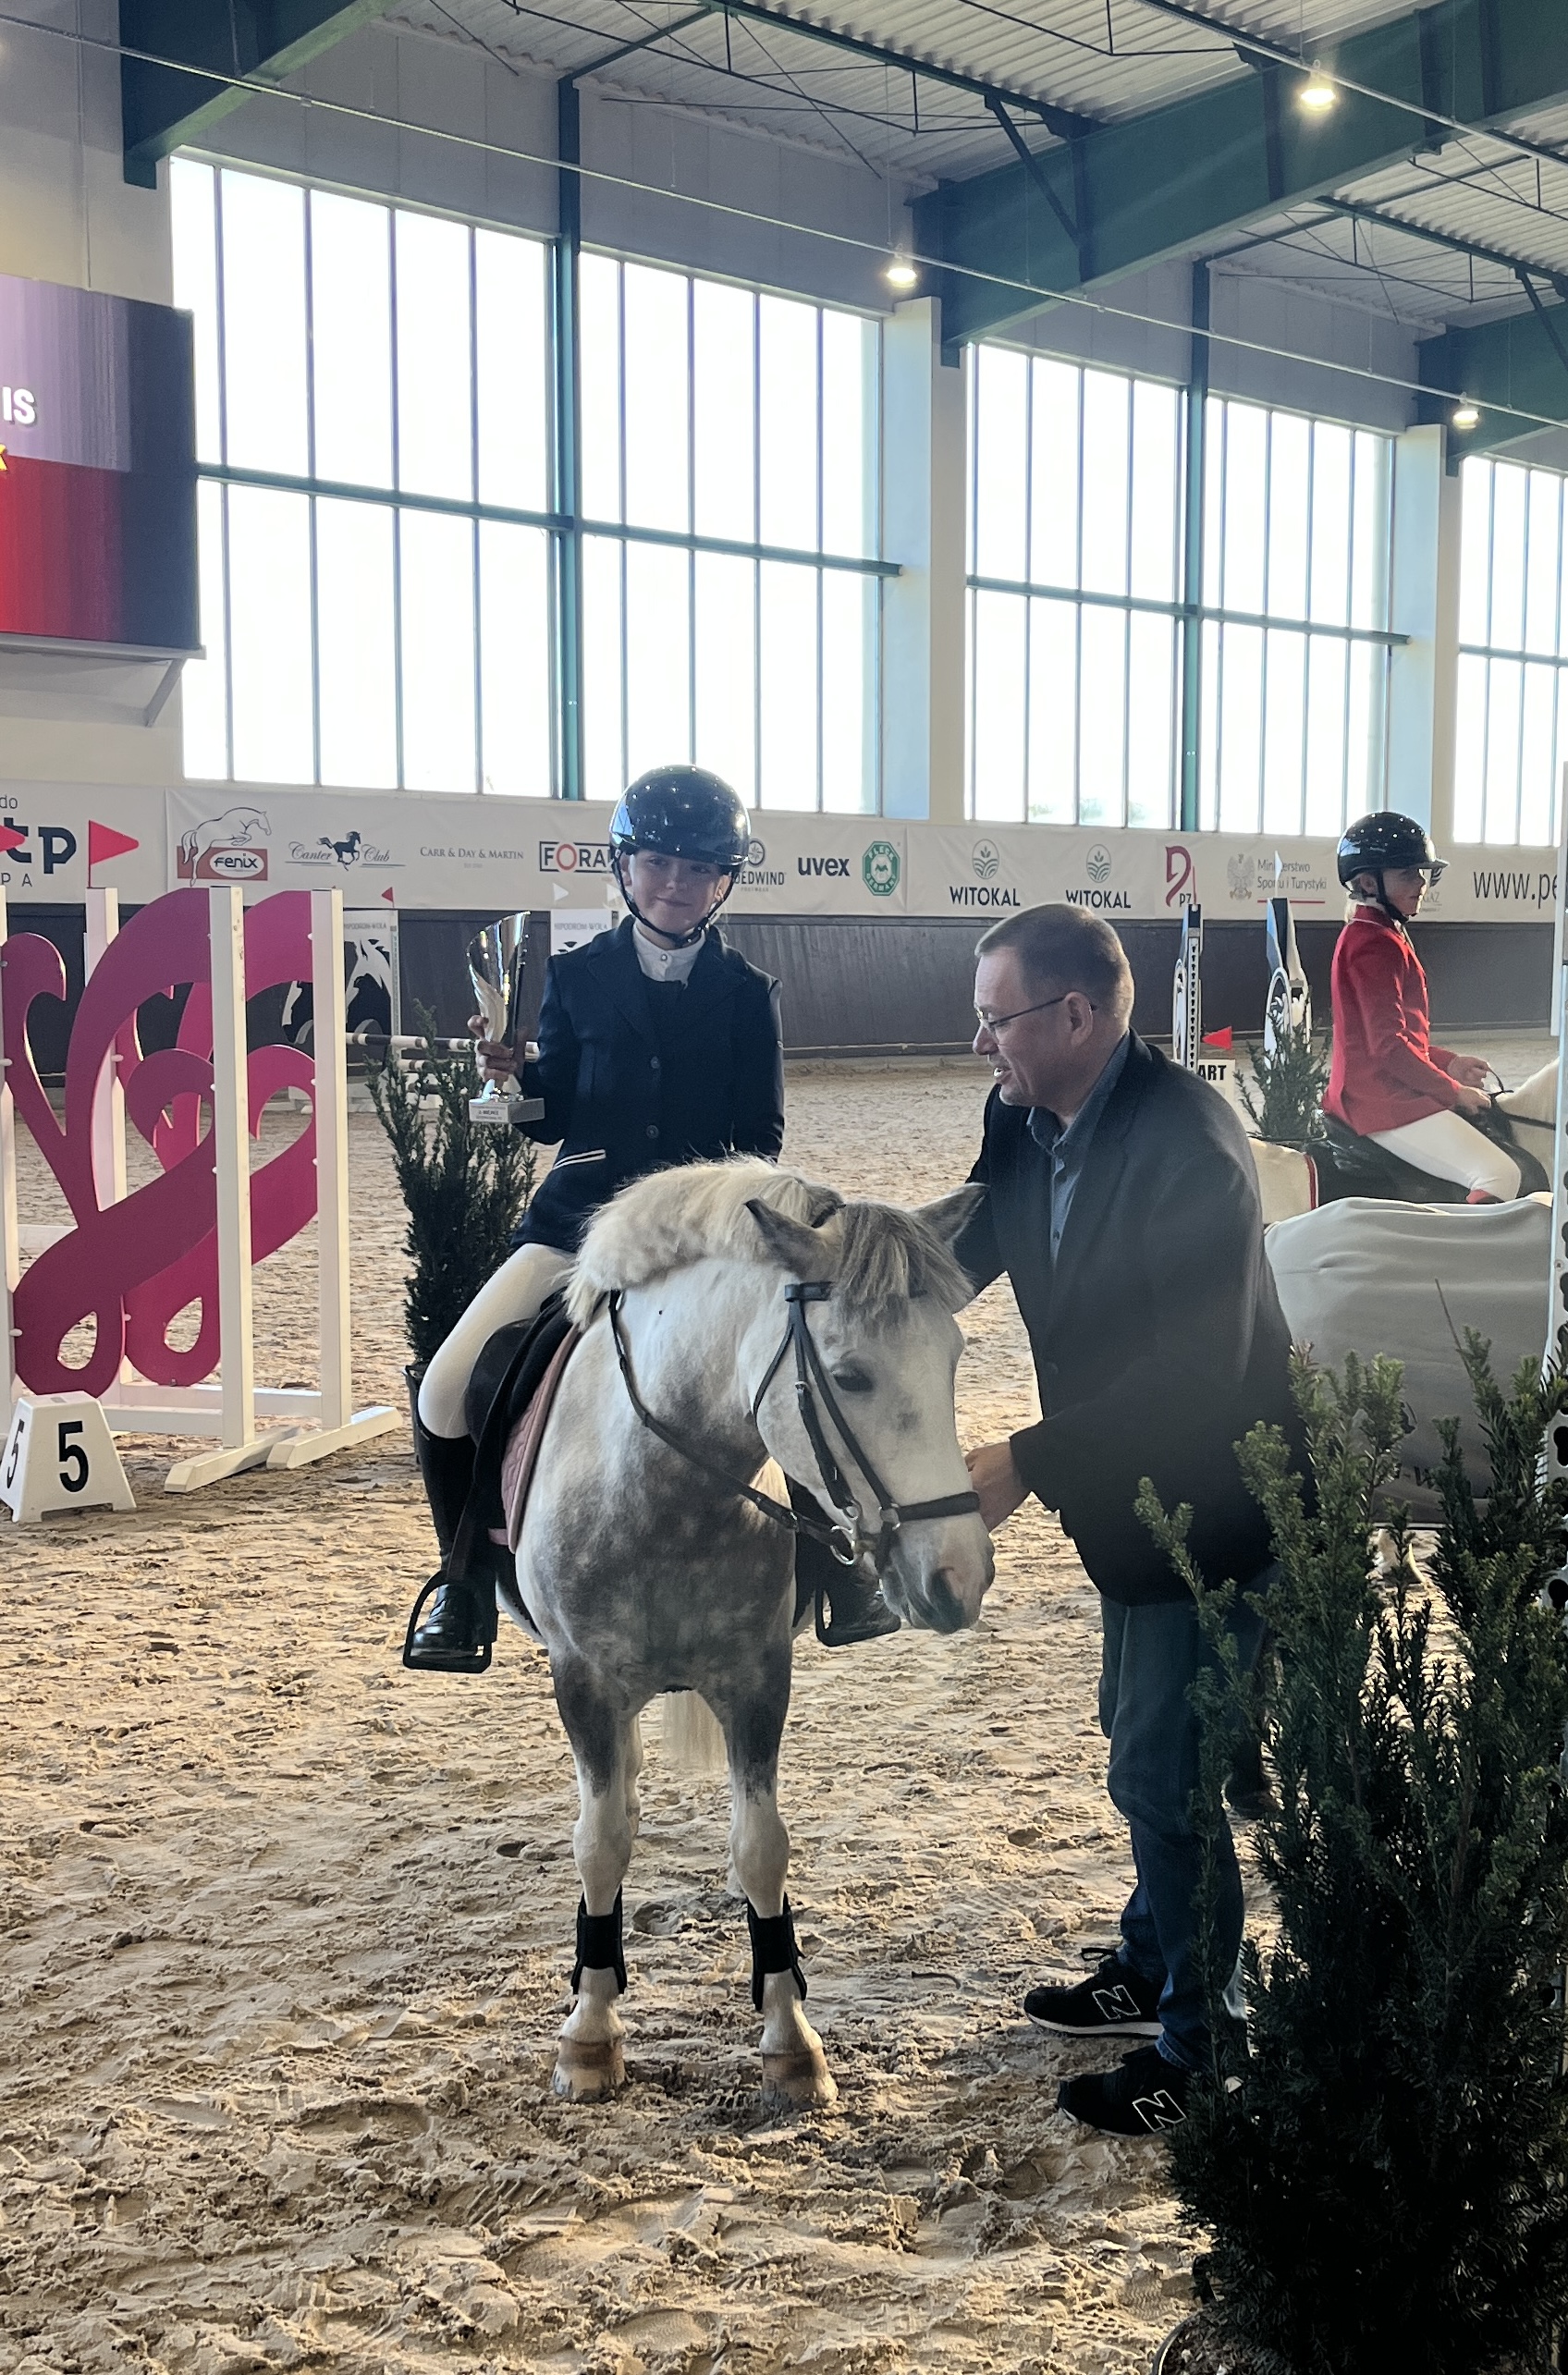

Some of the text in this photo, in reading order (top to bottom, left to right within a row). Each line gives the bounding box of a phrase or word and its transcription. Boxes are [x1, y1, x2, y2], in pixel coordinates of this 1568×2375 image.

[2, 386, 36, 424] IS
[0, 795, 18, 809] do
[214, 852, 259, 869] fenix
[288, 841, 390, 863] Canter Club
[447, 848, 456, 857] &
[479, 849, 486, 859] &
[798, 857, 851, 876] uvex
[1257, 859, 1311, 873] Minerstwo
[1257, 875, 1284, 891] Sporu
[949, 886, 1021, 907] WITOKAL
[1065, 889, 1132, 909] WITOKAL
[7, 1419, 25, 1489] 5
[58, 1420, 89, 1493] 5
[1092, 1985, 1141, 2020] N
[1133, 2089, 1187, 2132] N
